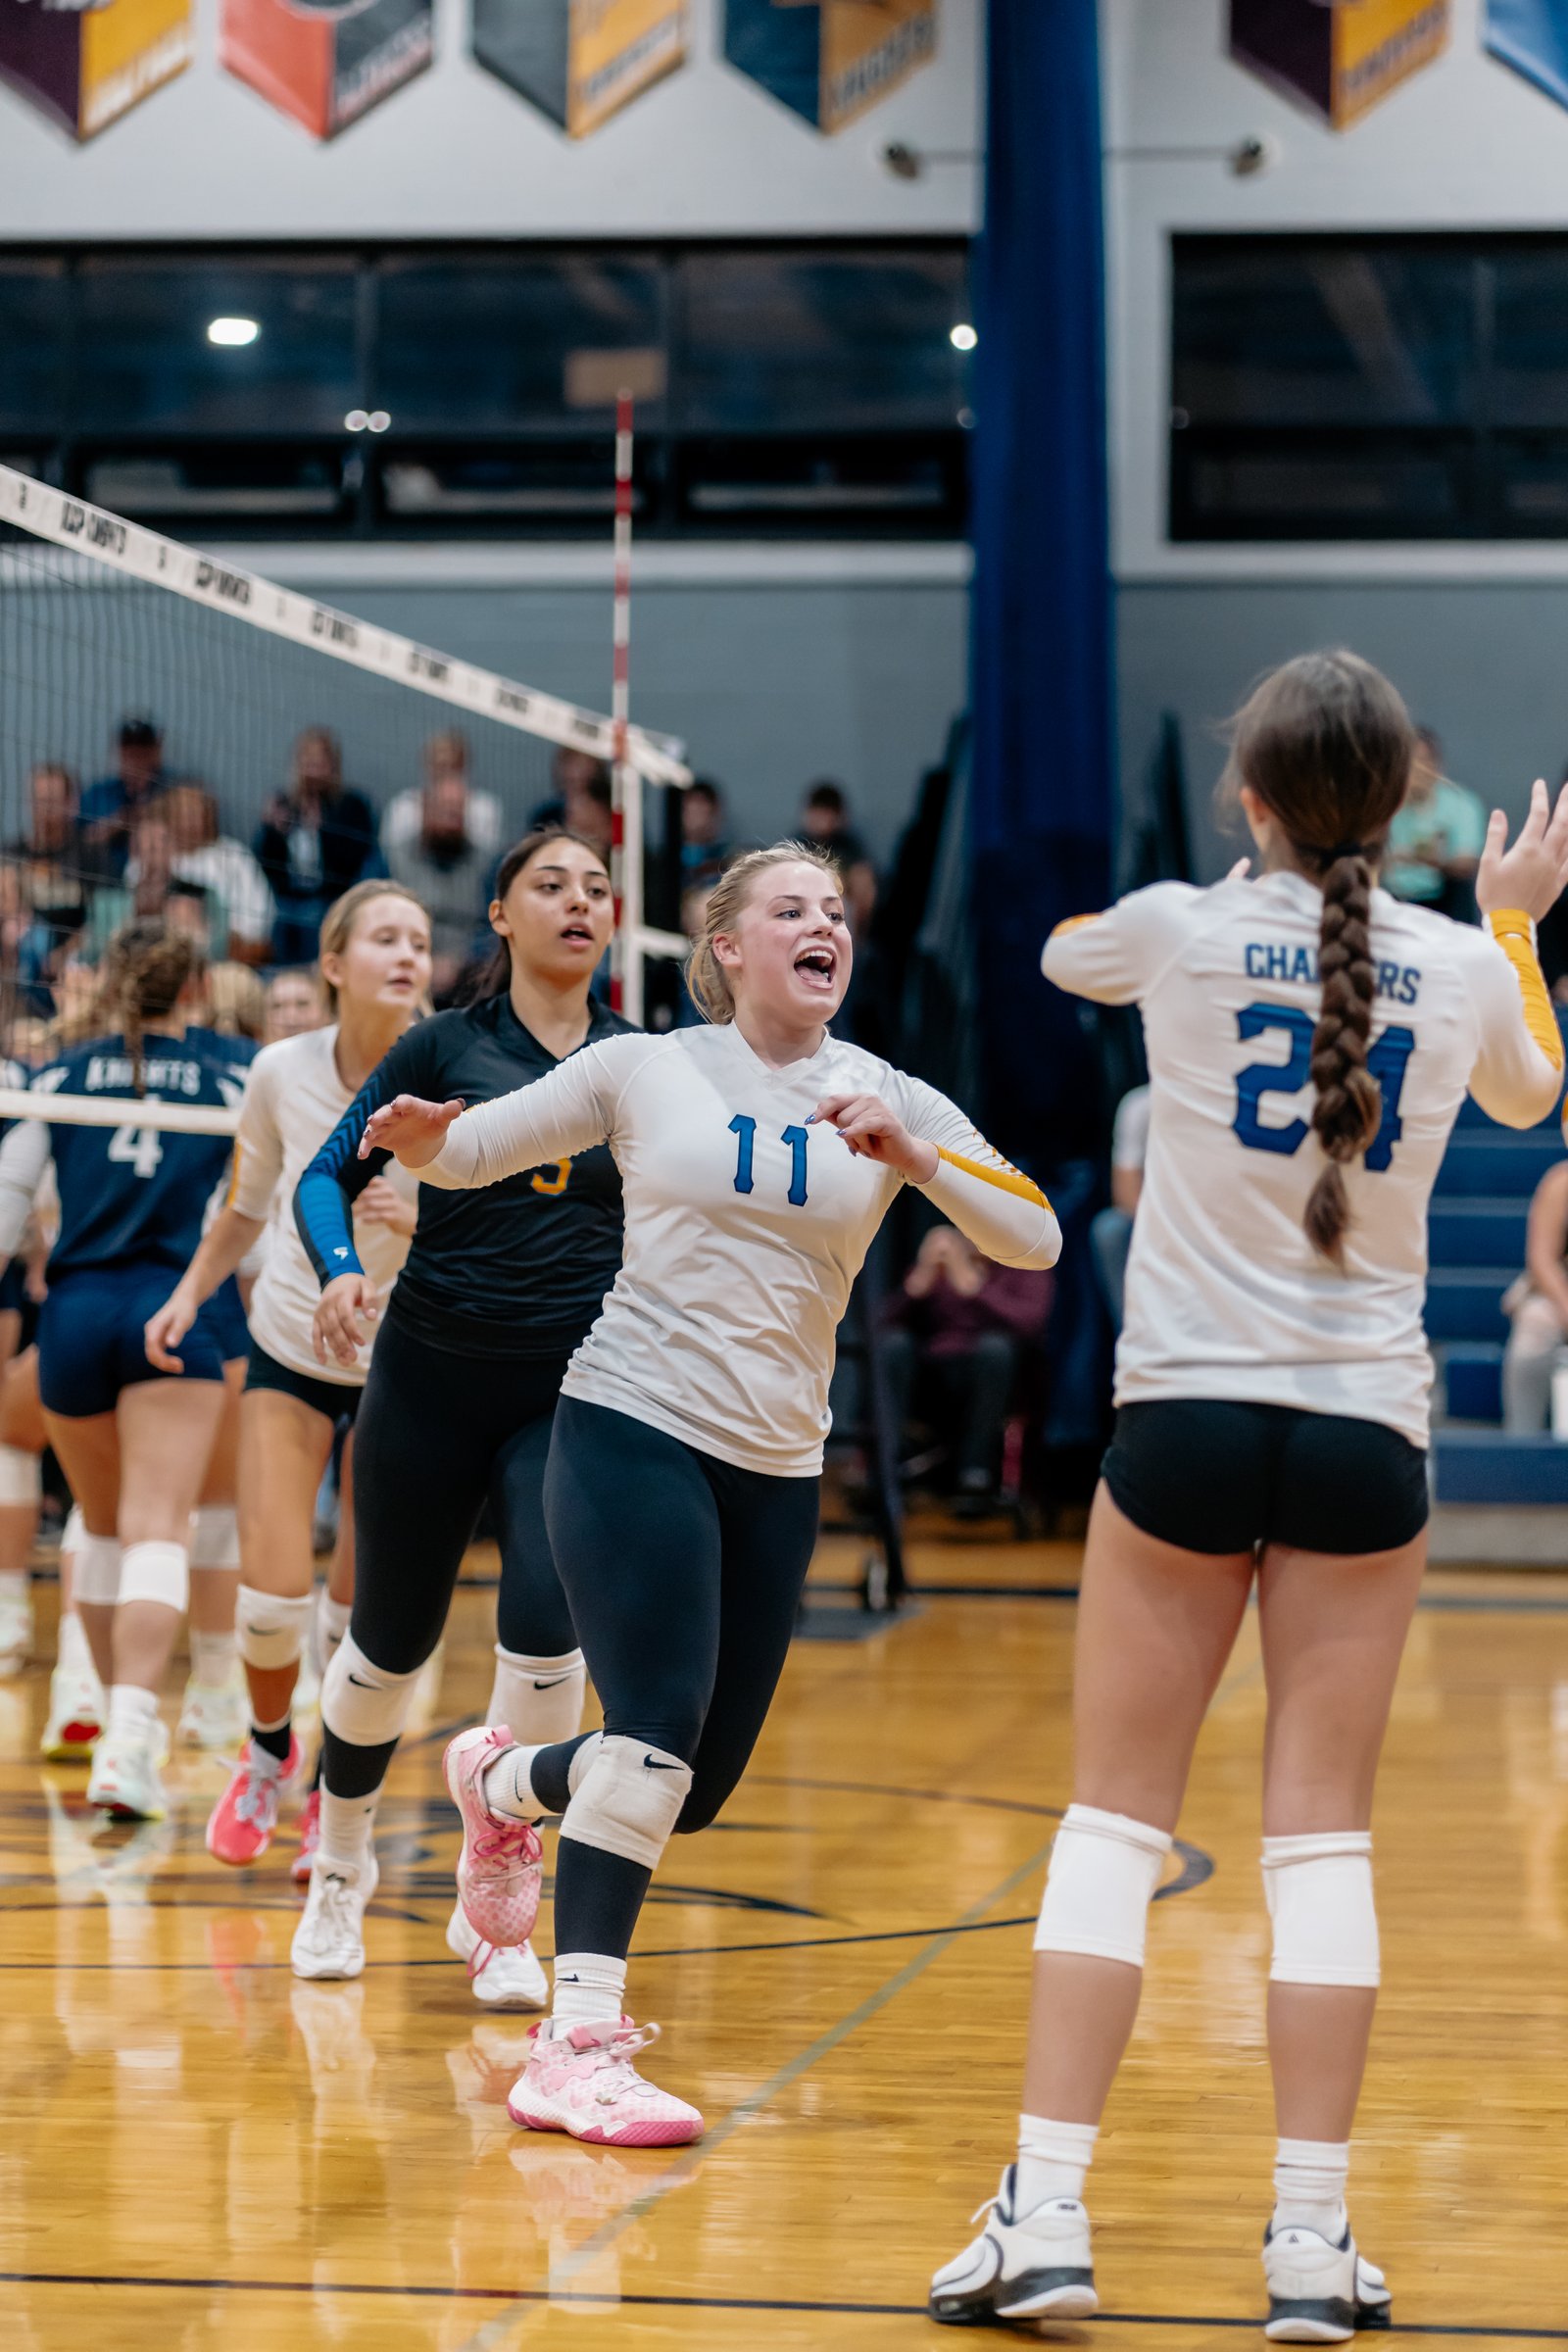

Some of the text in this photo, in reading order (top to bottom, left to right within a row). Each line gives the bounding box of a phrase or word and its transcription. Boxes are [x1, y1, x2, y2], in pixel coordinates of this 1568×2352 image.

[1244, 942, 1422, 1005] CHARS
[107, 1093, 164, 1179] 4
[727, 1113, 809, 1207] 11
